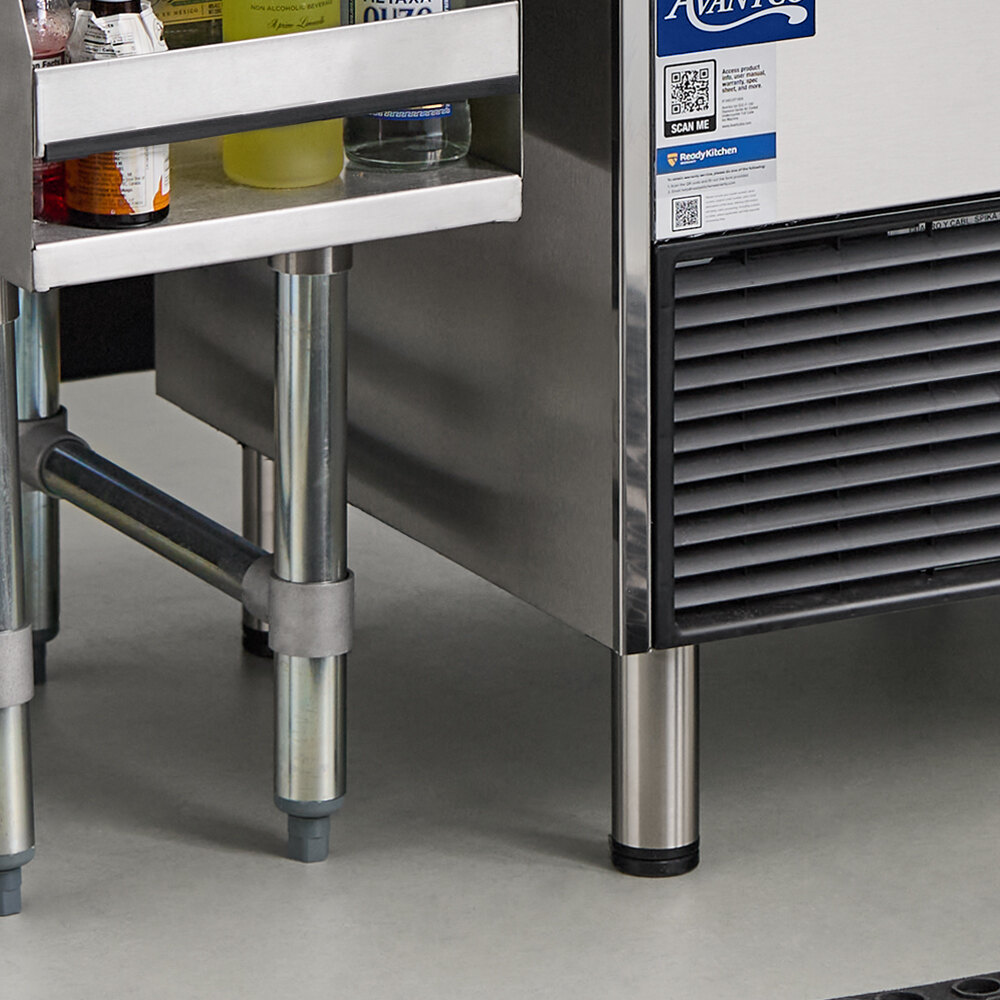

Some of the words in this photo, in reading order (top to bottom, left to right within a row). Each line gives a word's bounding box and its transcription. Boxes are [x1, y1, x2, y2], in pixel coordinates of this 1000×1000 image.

[740, 64, 760, 73] product
[671, 121, 695, 134] SCAN
[696, 119, 710, 130] ME
